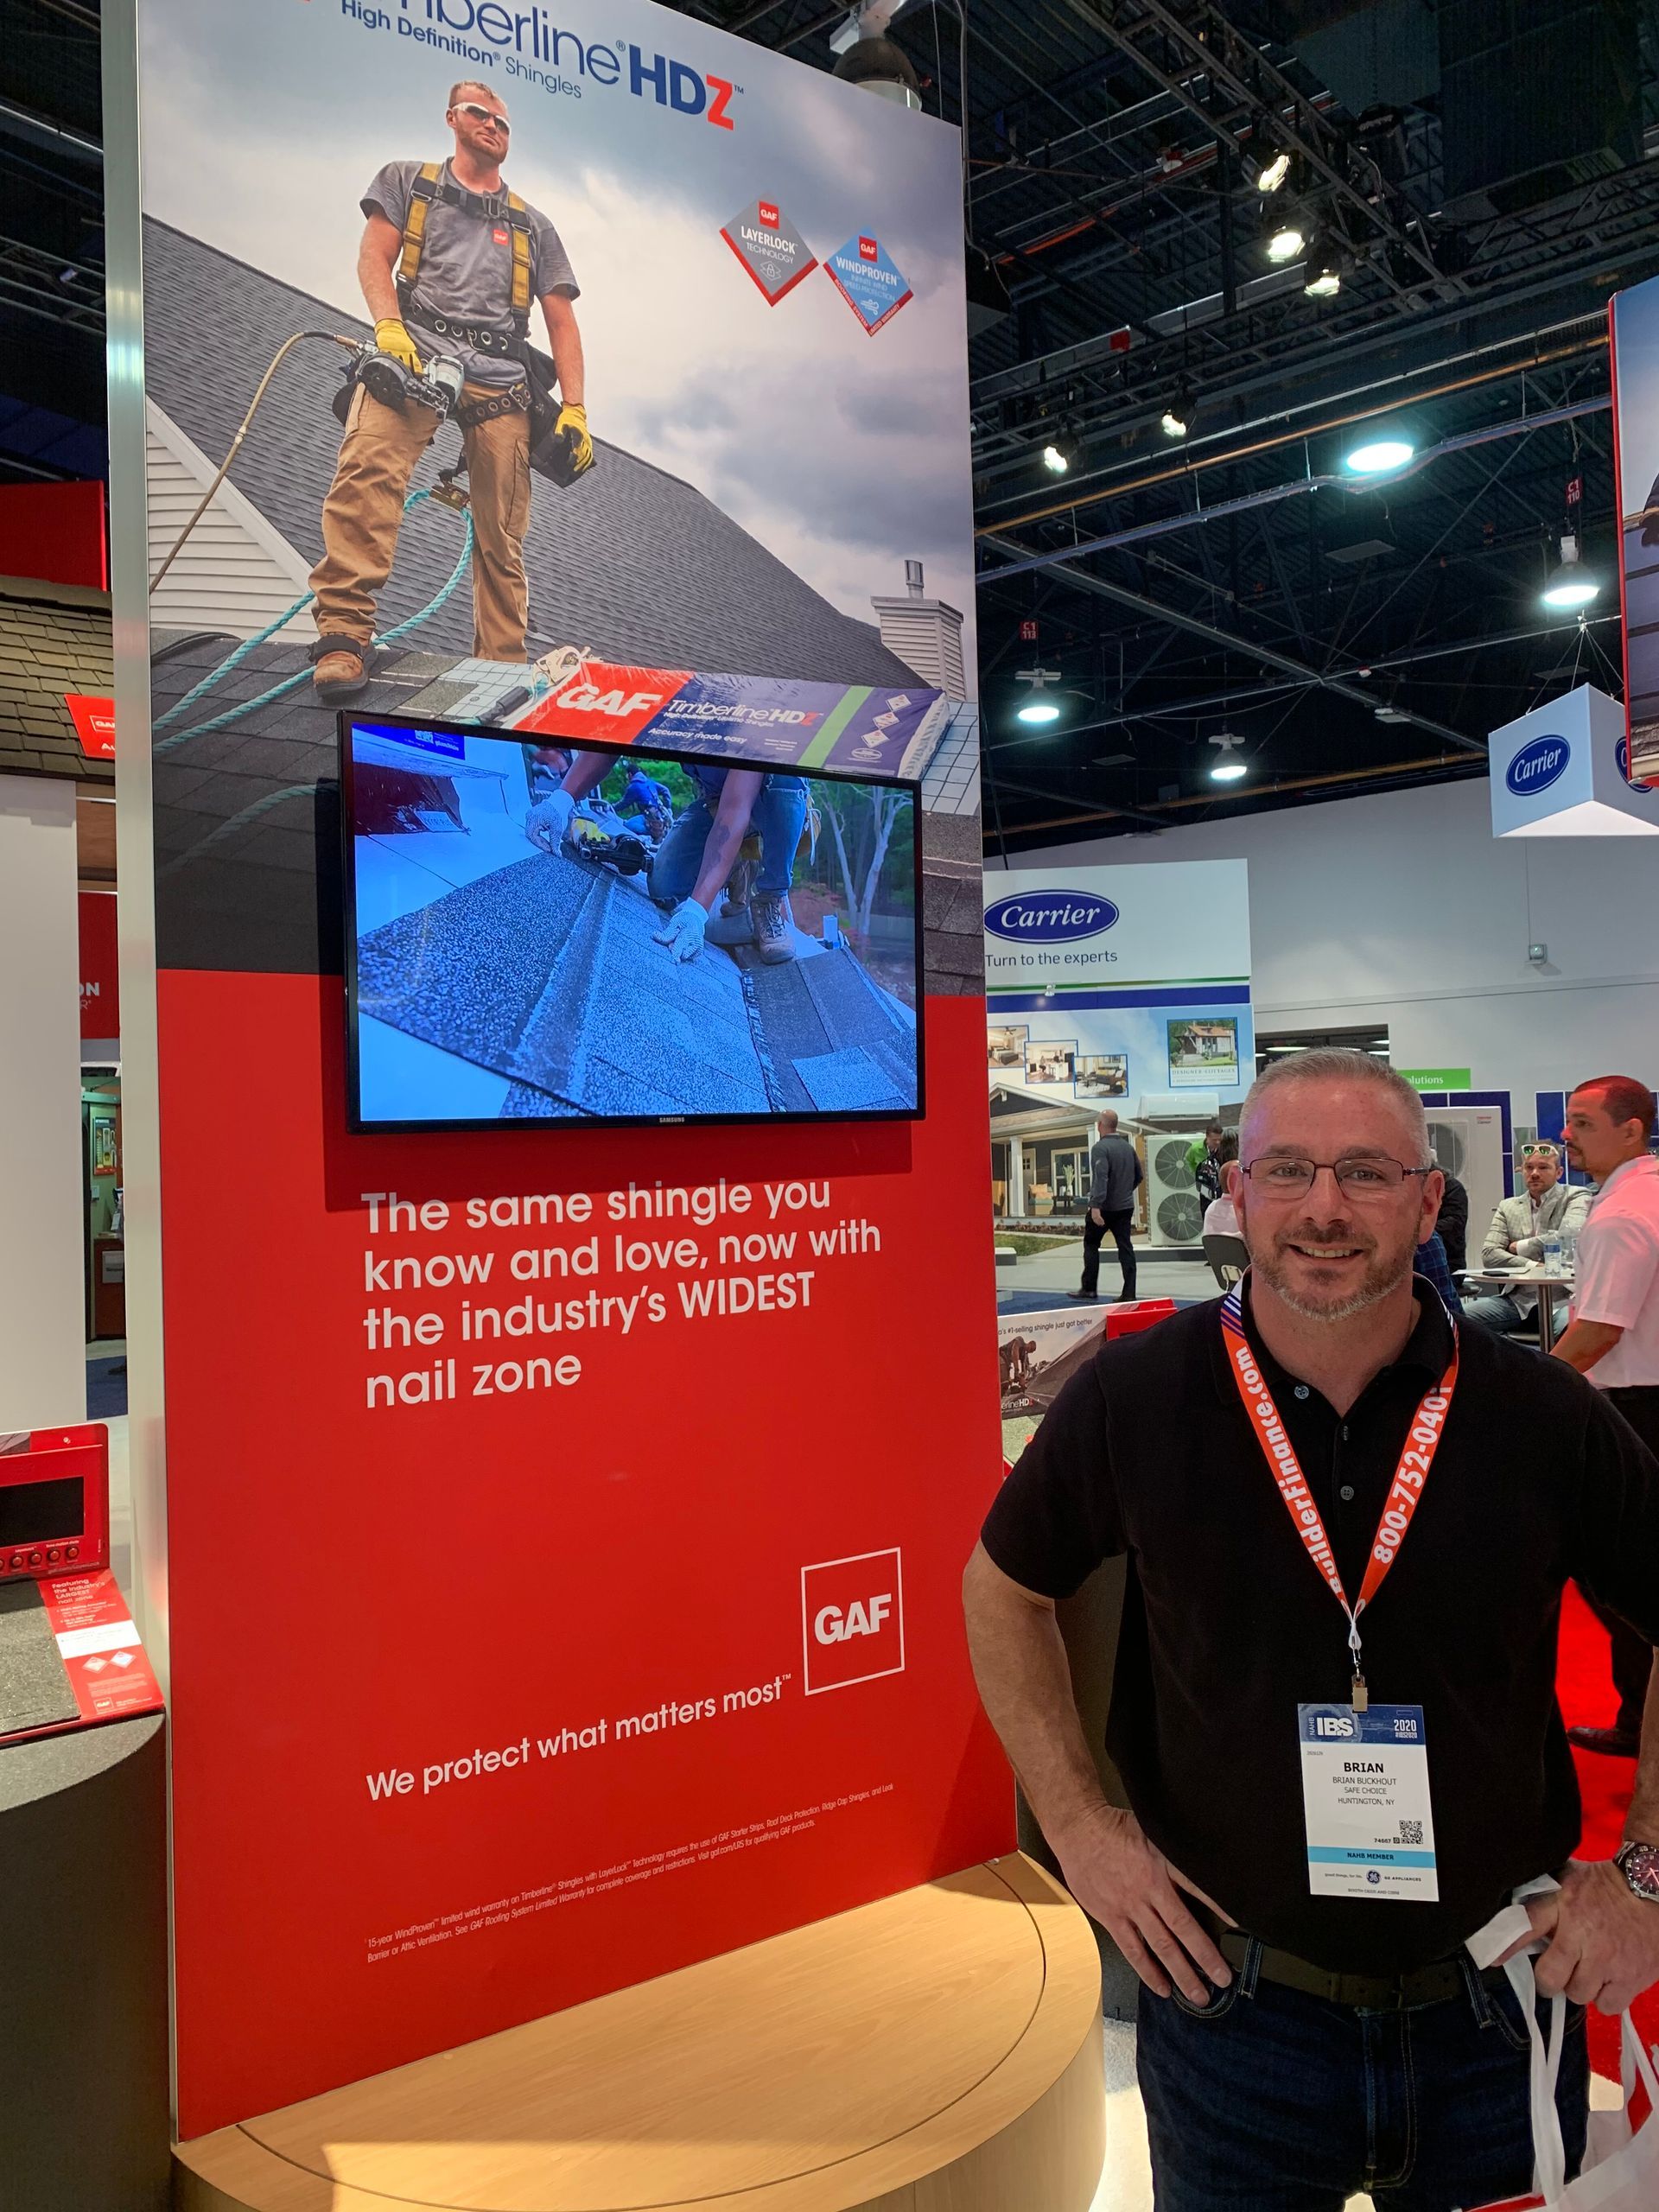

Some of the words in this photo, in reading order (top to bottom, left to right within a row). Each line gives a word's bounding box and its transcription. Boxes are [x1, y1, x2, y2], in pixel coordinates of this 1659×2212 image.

[341, 0, 391, 30] High
[505, 56, 582, 99] Shingles
[760, 208, 778, 221] GAF
[746, 242, 794, 264] TECHNOLOGY
[860, 242, 876, 255] GAF
[556, 683, 664, 716] GAF
[648, 728, 692, 739] Accuracy
[695, 732, 722, 741] made
[724, 735, 747, 744] easy
[1515, 747, 1561, 783] Carrier
[1001, 904, 1101, 928] Carrier
[985, 954, 1017, 967] Turn
[1021, 954, 1034, 966] to
[1039, 952, 1060, 965] the
[1065, 950, 1118, 966] experts
[361, 1192, 449, 1234] The
[466, 1190, 593, 1229] same
[607, 1177, 753, 1226] shingle
[764, 1181, 830, 1219] you
[364, 1250, 494, 1292] know
[510, 1236, 599, 1281] and
[615, 1235, 708, 1273] love,
[719, 1231, 798, 1264] now
[809, 1219, 881, 1256] with
[363, 1307, 444, 1351] the
[461, 1285, 666, 1342] industry's
[677, 1271, 815, 1319] WIDEST
[1034, 1323, 1054, 1332] shingle
[1055, 1321, 1065, 1330] just
[1065, 1320, 1076, 1329] got
[366, 1358, 455, 1408] nail
[473, 1353, 582, 1397] zone
[52, 1580, 90, 1589] Featuring
[55, 1589, 90, 1599] LARGEST
[814, 1592, 892, 1645] GAF
[1316, 1717, 1354, 1737] IBS
[1394, 1719, 1417, 1732] 2020
[365, 1768, 415, 1801] We
[423, 1736, 530, 1793] protect
[537, 1721, 607, 1760] what
[614, 1697, 716, 1741] matters
[1344, 1762, 1384, 1773] BRIAN
[1357, 1777, 1396, 1785] BUCKHOUT
[1338, 1797, 1383, 1806] HUNTINGTON,
[441, 1911, 462, 1925] limited
[464, 1906, 480, 1918] wind
[481, 1898, 509, 1912] warranty
[511, 1896, 519, 1904] on
[558, 1876, 583, 1890] Shingles
[585, 1872, 597, 1882] with
[632, 1853, 665, 1867] Technology
[665, 1845, 688, 1858] requires
[690, 1842, 699, 1851] the
[700, 1839, 710, 1847] use
[711, 1834, 718, 1844] of
[718, 1832, 730, 1842] GAF
[731, 1826, 748, 1839] Starter
[766, 1817, 779, 1827] Roof
[779, 1813, 793, 1824] Deck
[822, 1800, 836, 1811] Ridge
[836, 1797, 848, 1807] Cap
[871, 1786, 881, 1796] and
[882, 1783, 893, 1793] Leak
[367, 1950, 390, 1963] Barrier
[391, 1947, 398, 1955] or
[401, 1942, 416, 1953] Attic
[455, 1925, 468, 1936] See
[470, 1919, 484, 1930] GAF
[485, 1912, 510, 1927] Roofing
[511, 1904, 534, 1918] System
[536, 1897, 557, 1910] Limited
[559, 1889, 586, 1904] Warranty
[596, 1878, 624, 1892] complete
[625, 1869, 652, 1884] coverage
[652, 1865, 664, 1875] and
[697, 1851, 709, 1861] Visit
[753, 1830, 779, 1846] qualifying
[779, 1826, 791, 1836] GAF
